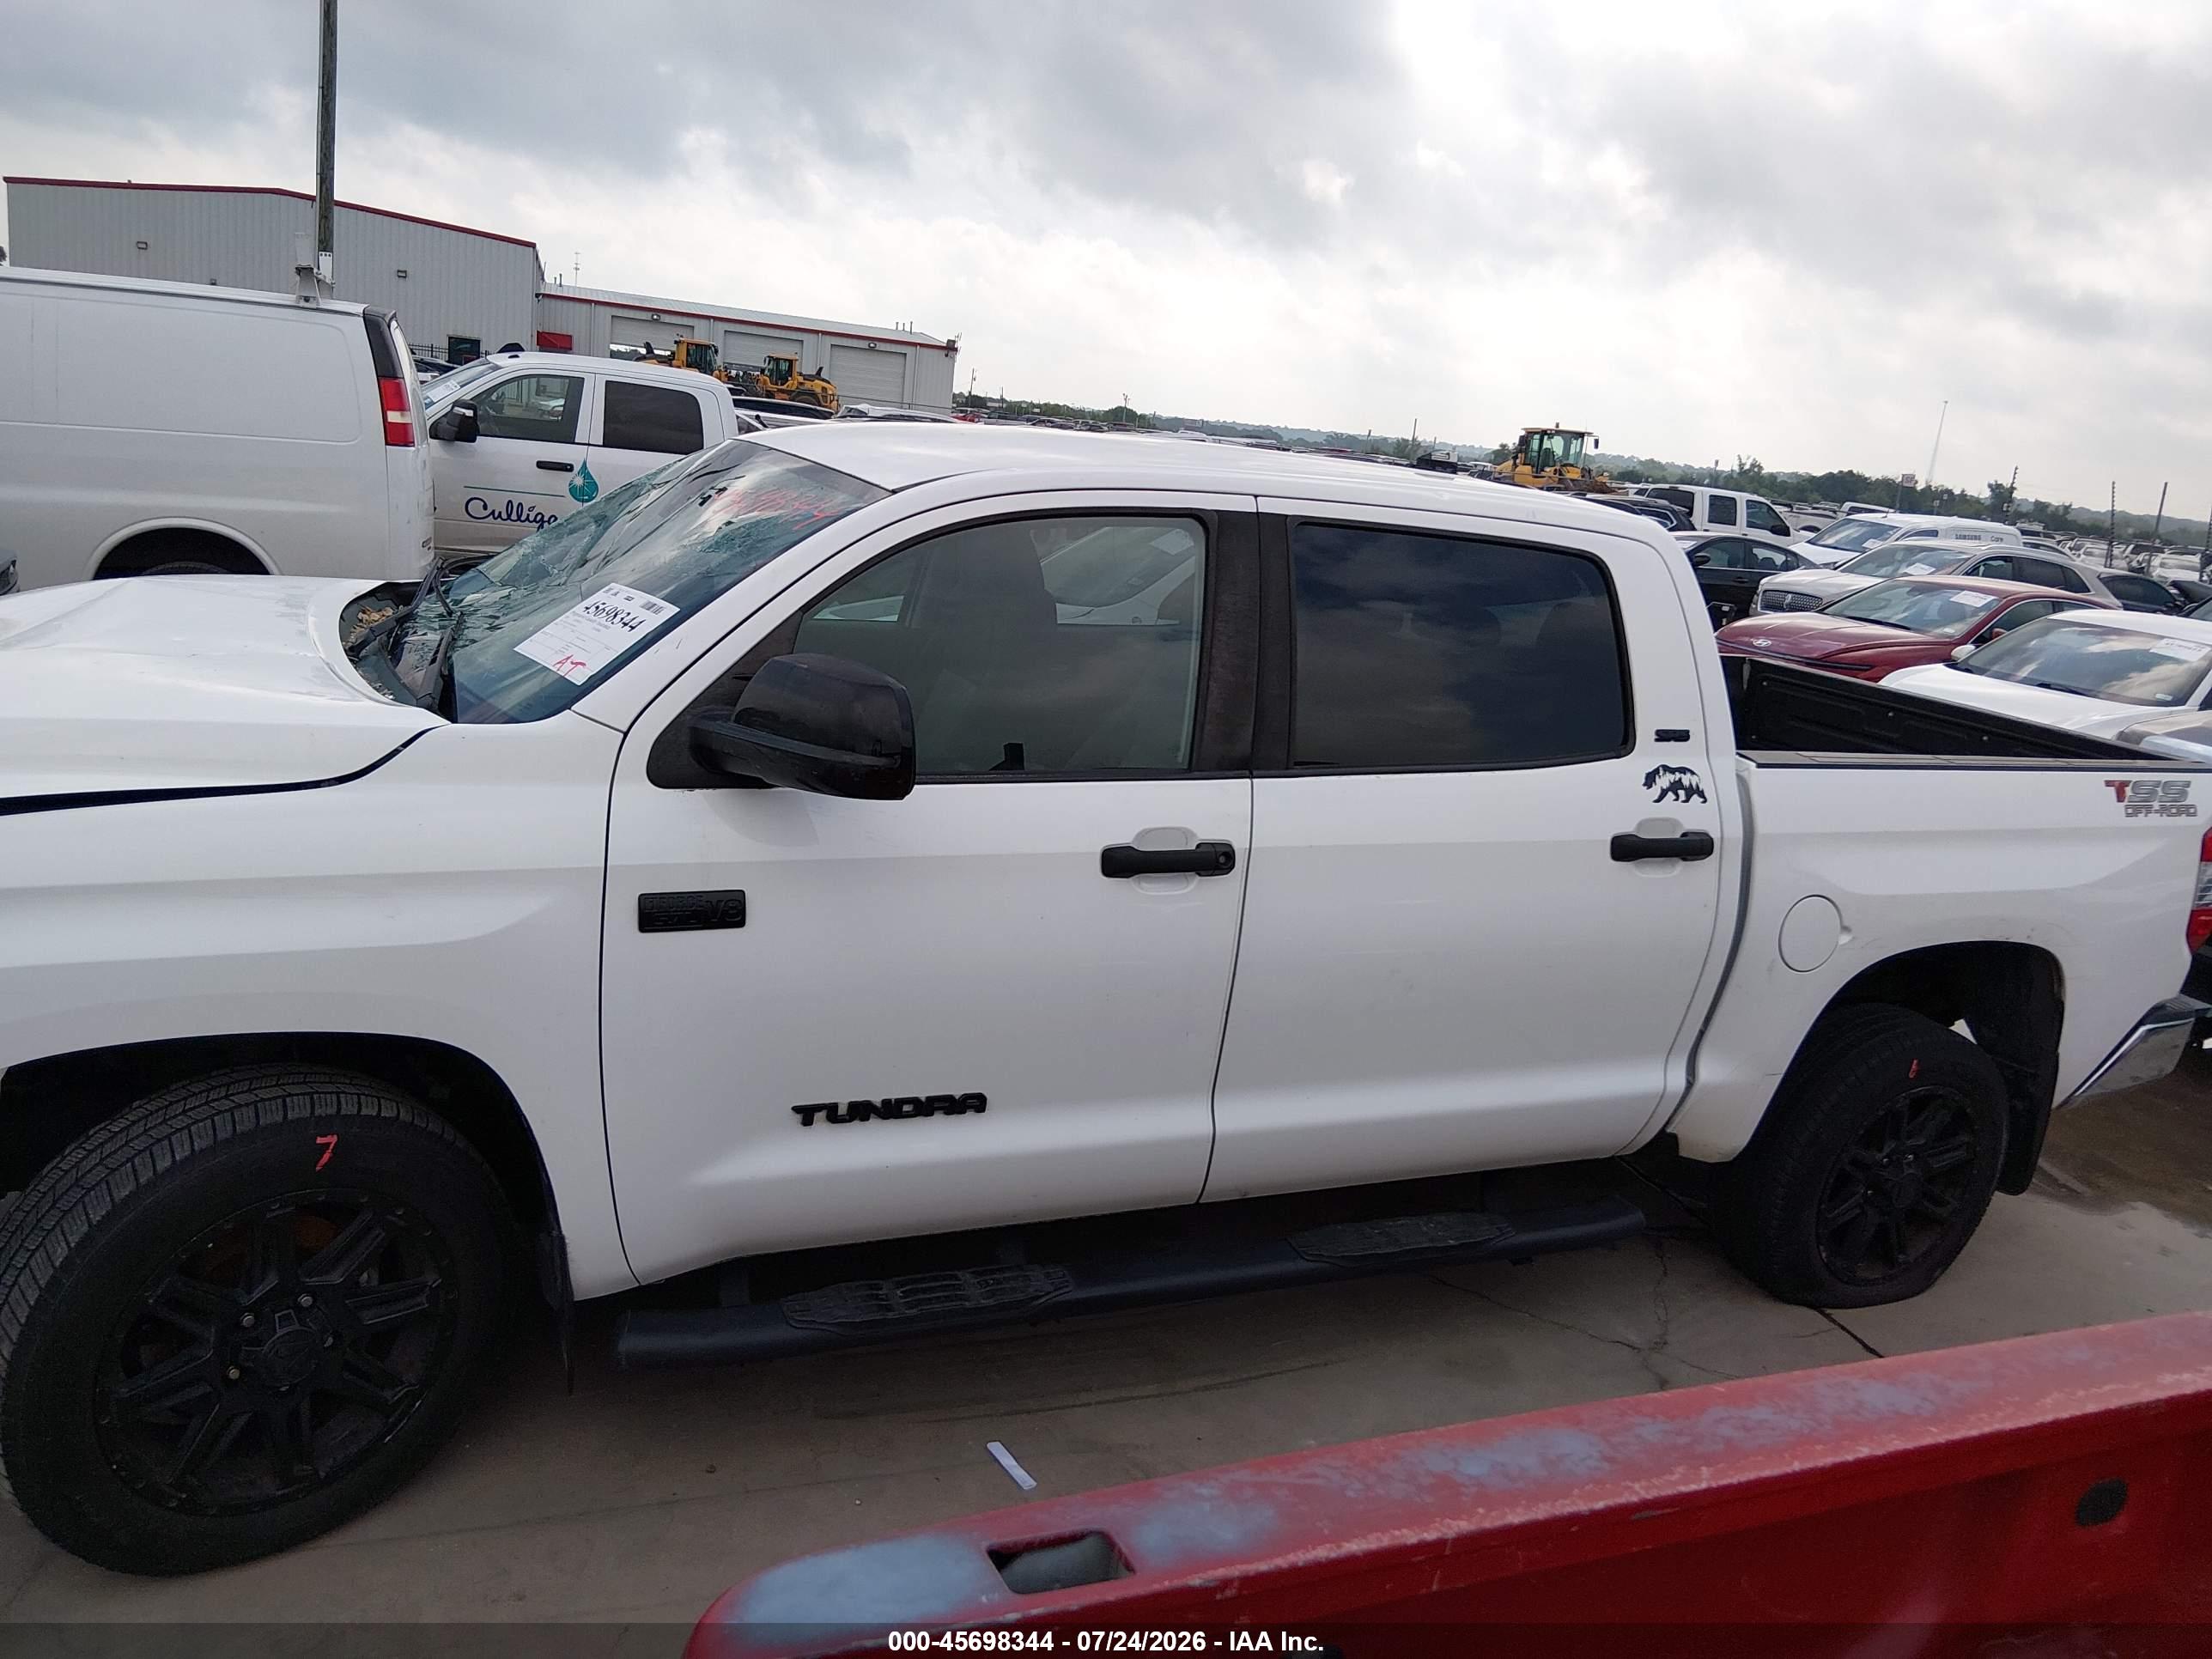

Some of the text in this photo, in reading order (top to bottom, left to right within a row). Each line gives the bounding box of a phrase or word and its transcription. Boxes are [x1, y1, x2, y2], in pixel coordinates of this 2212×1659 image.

[465, 497, 558, 533] Culliga
[583, 601, 647, 632] 45698344
[2104, 780, 2191, 803] TSS
[2124, 805, 2197, 817] OFF-ROAD
[791, 1092, 988, 1127] TUNDRA
[315, 1133, 337, 1172] 7
